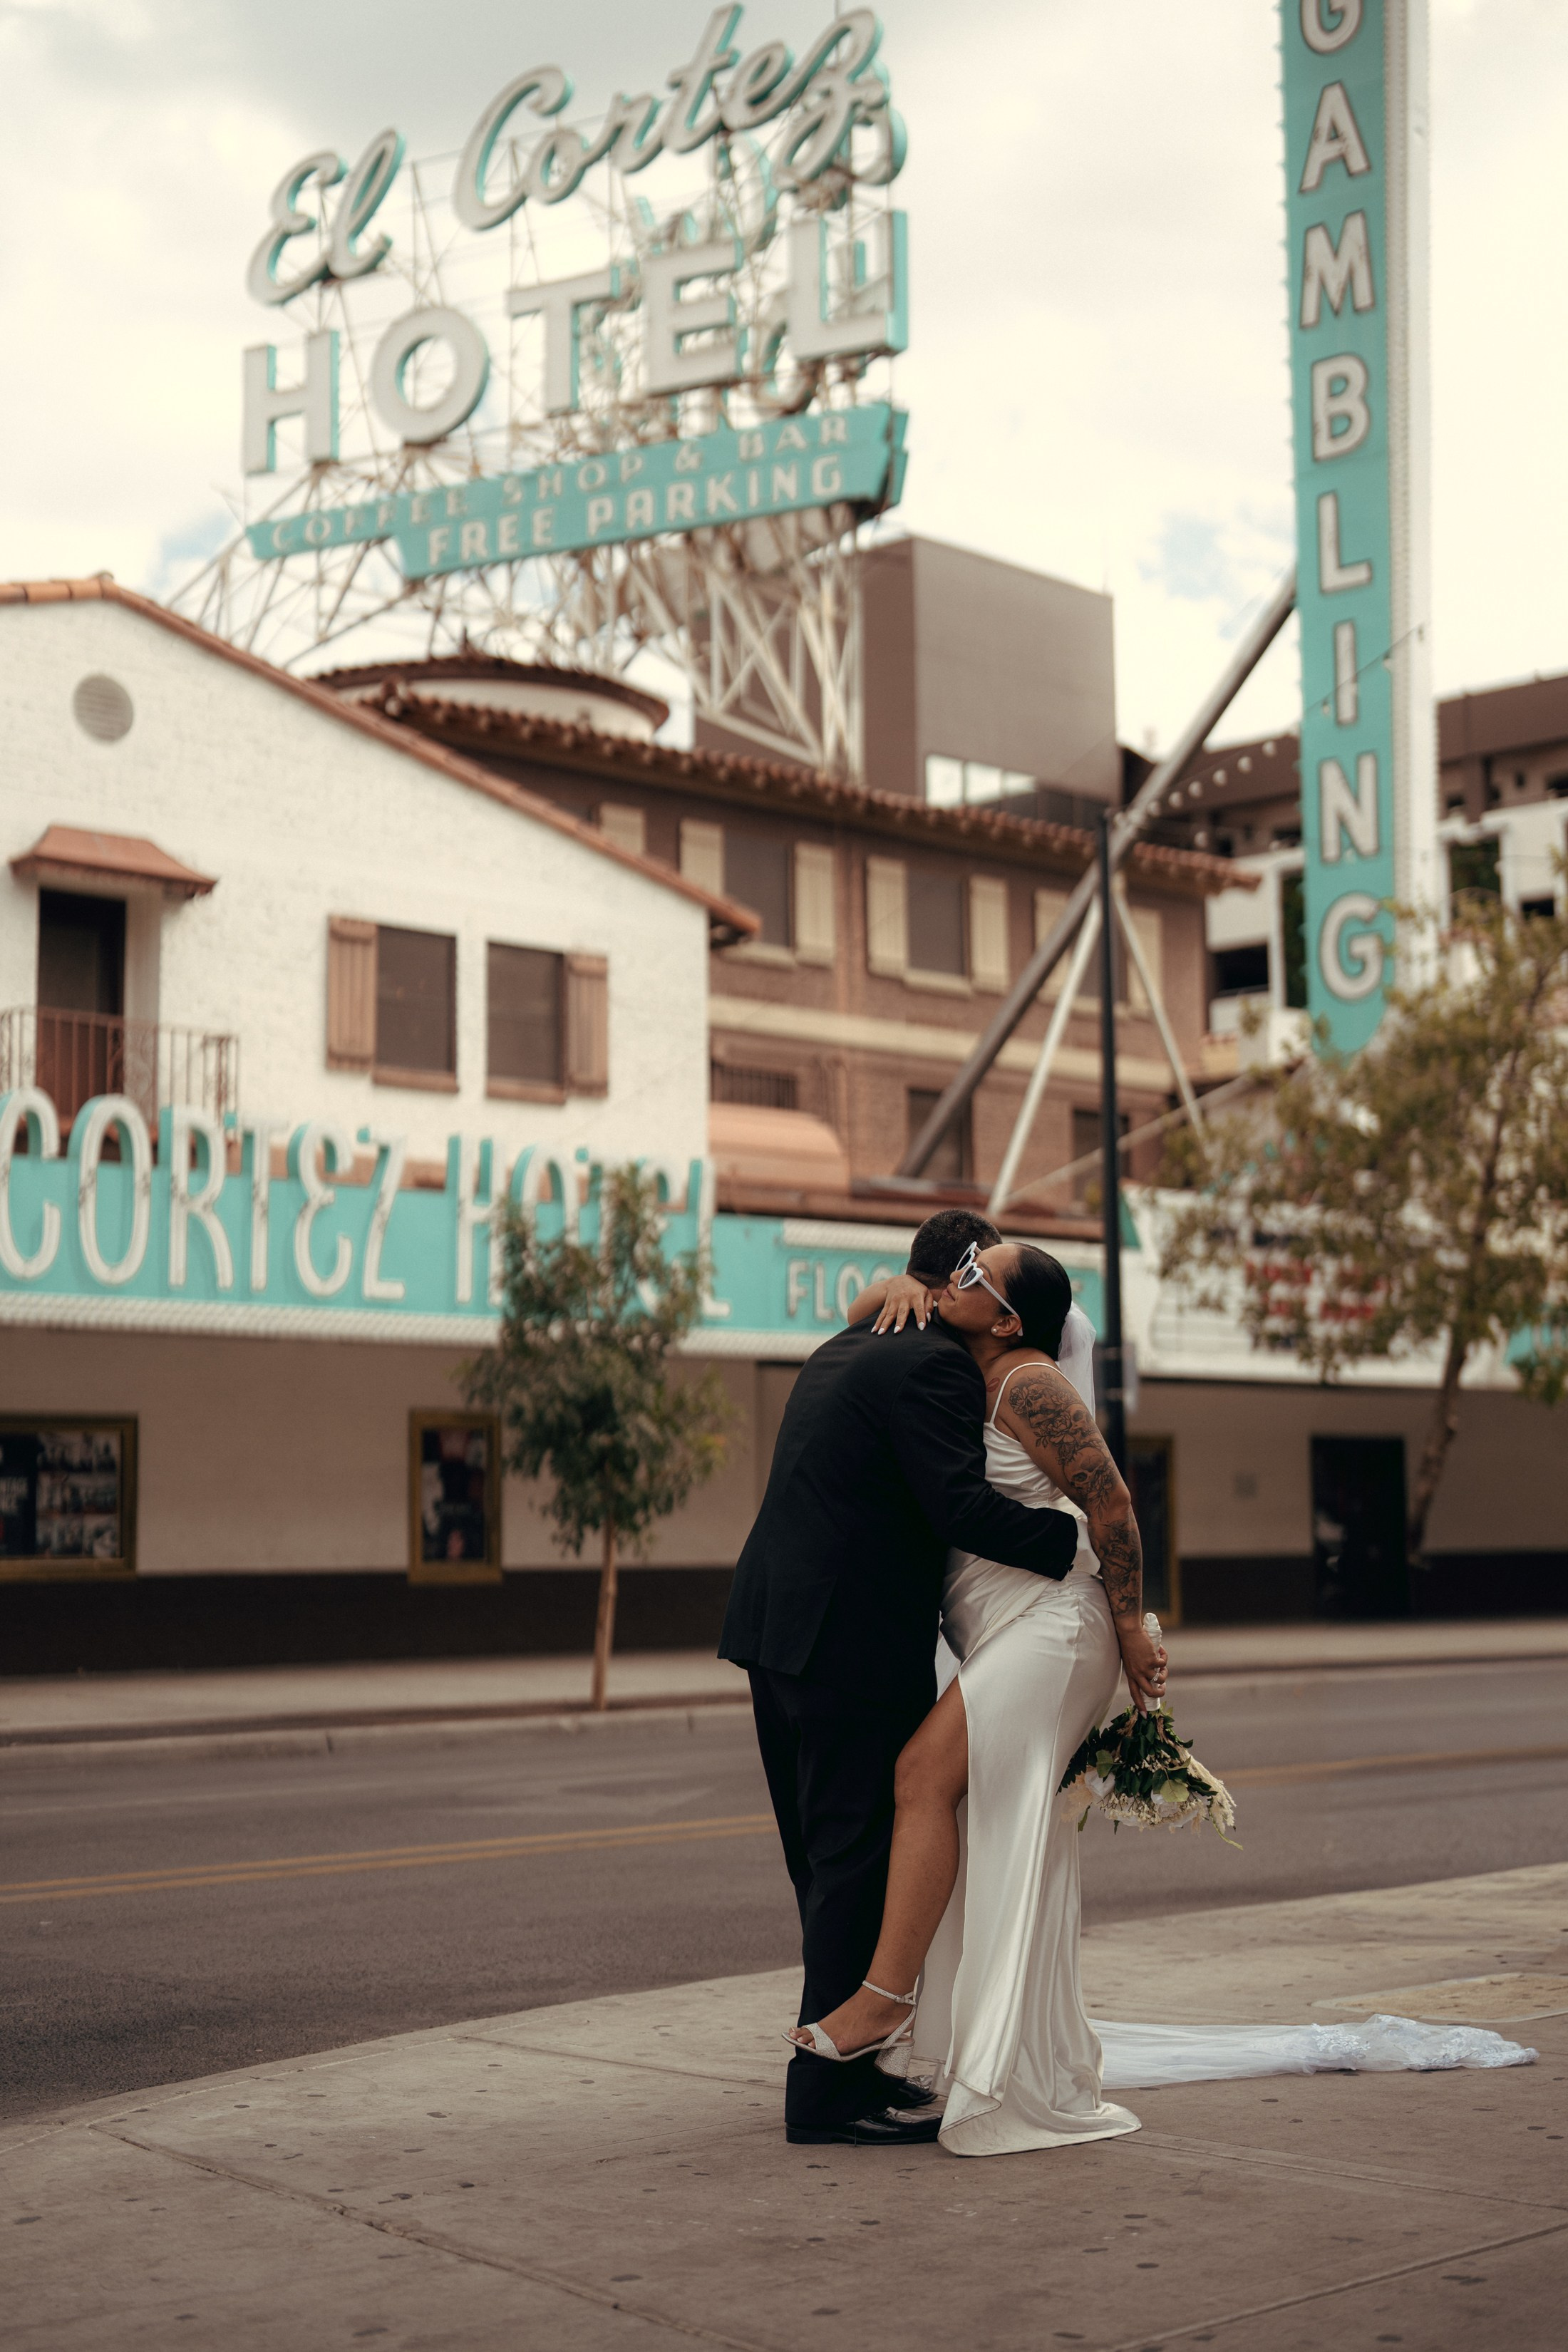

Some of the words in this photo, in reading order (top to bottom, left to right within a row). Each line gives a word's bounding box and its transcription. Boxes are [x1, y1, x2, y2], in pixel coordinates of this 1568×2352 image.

[247, 128, 405, 307] El
[452, 1, 892, 232] Cortez
[242, 209, 905, 477] HOTEL
[428, 507, 555, 567] FREE
[586, 453, 843, 539] PARKING
[502, 454, 643, 505] SHOP
[674, 441, 703, 473] &
[738, 416, 848, 462] BAR
[0, 1086, 406, 1303] CORTEZ
[787, 1257, 907, 1321] FLO
